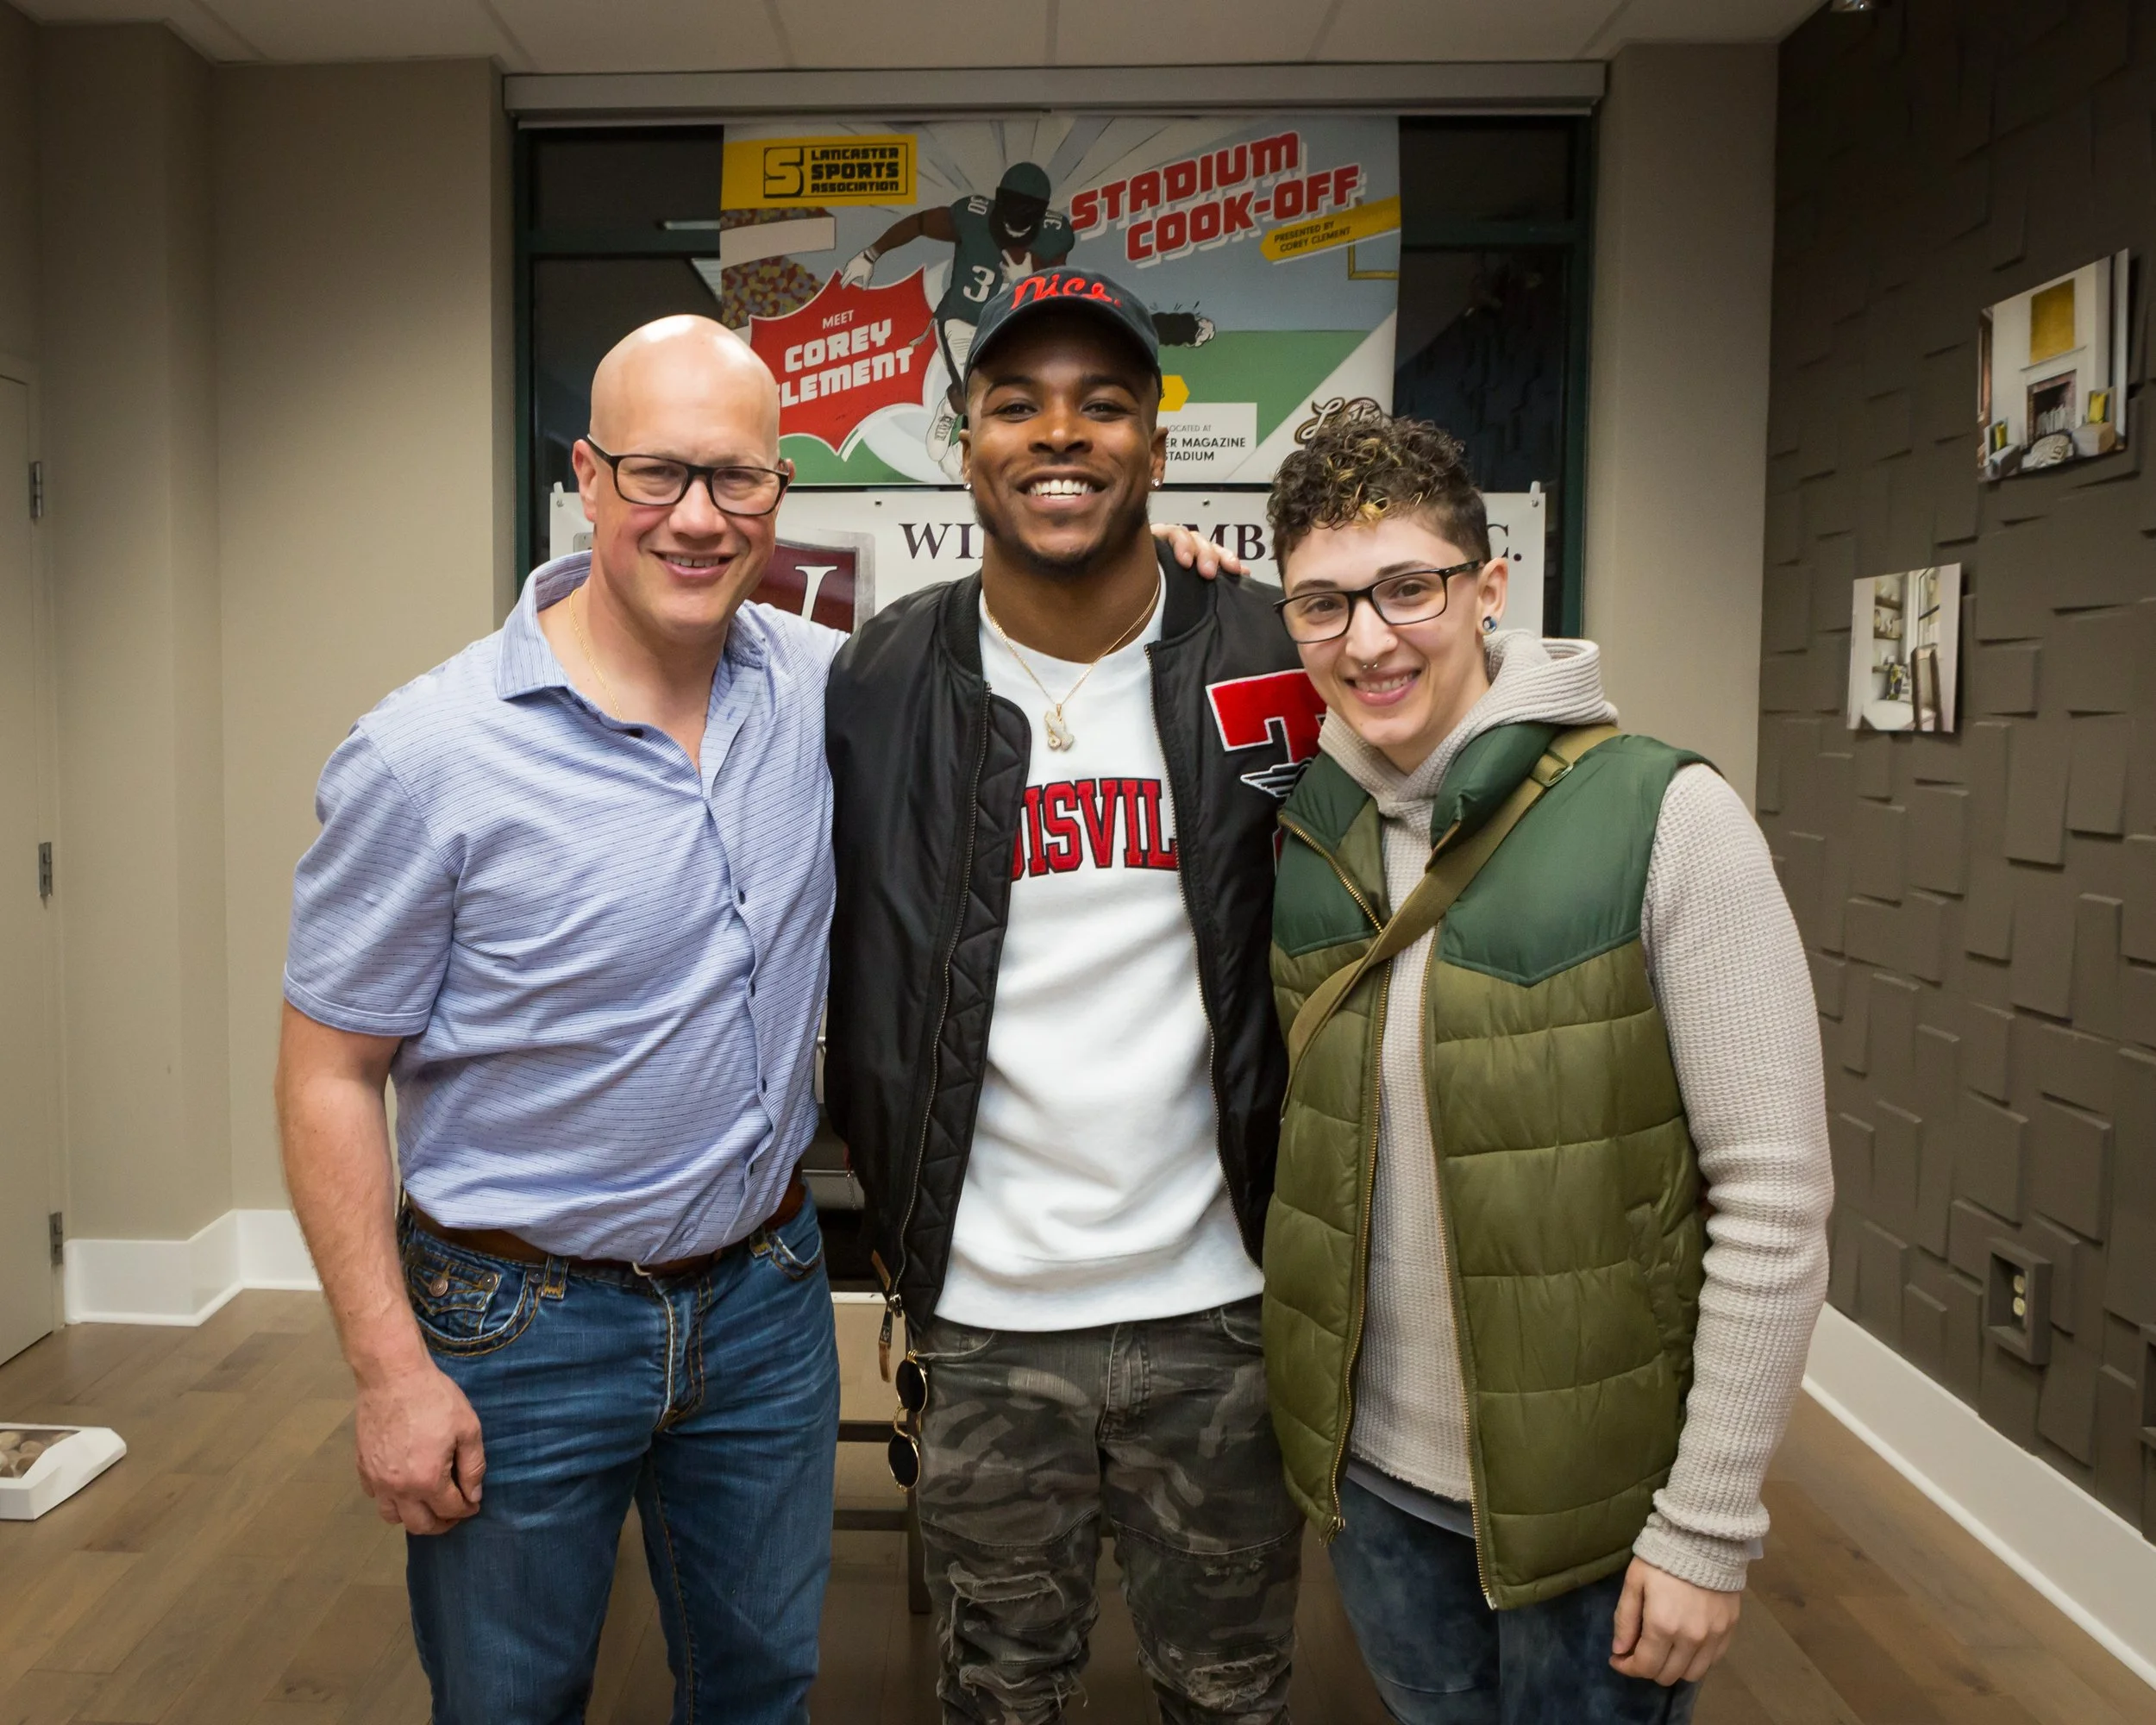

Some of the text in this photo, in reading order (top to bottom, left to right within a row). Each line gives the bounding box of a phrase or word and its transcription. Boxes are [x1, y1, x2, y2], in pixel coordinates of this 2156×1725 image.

[812, 147, 899, 160] LANCASTER
[812, 162, 899, 180] SPORTS
[1070, 131, 1300, 232] STADIUM
[812, 181, 899, 193] ASSOCIATION
[1126, 165, 1360, 261] COOK-OFF
[1274, 221, 1334, 242] PRESENTED BY
[1280, 226, 1351, 252] COREY CLEMENT
[822, 310, 855, 329] MEET
[785, 318, 892, 373] COREY
[777, 346, 914, 408] LEMENT
[1182, 437, 1245, 448] MAGAZINE
[898, 523, 983, 559] WI
